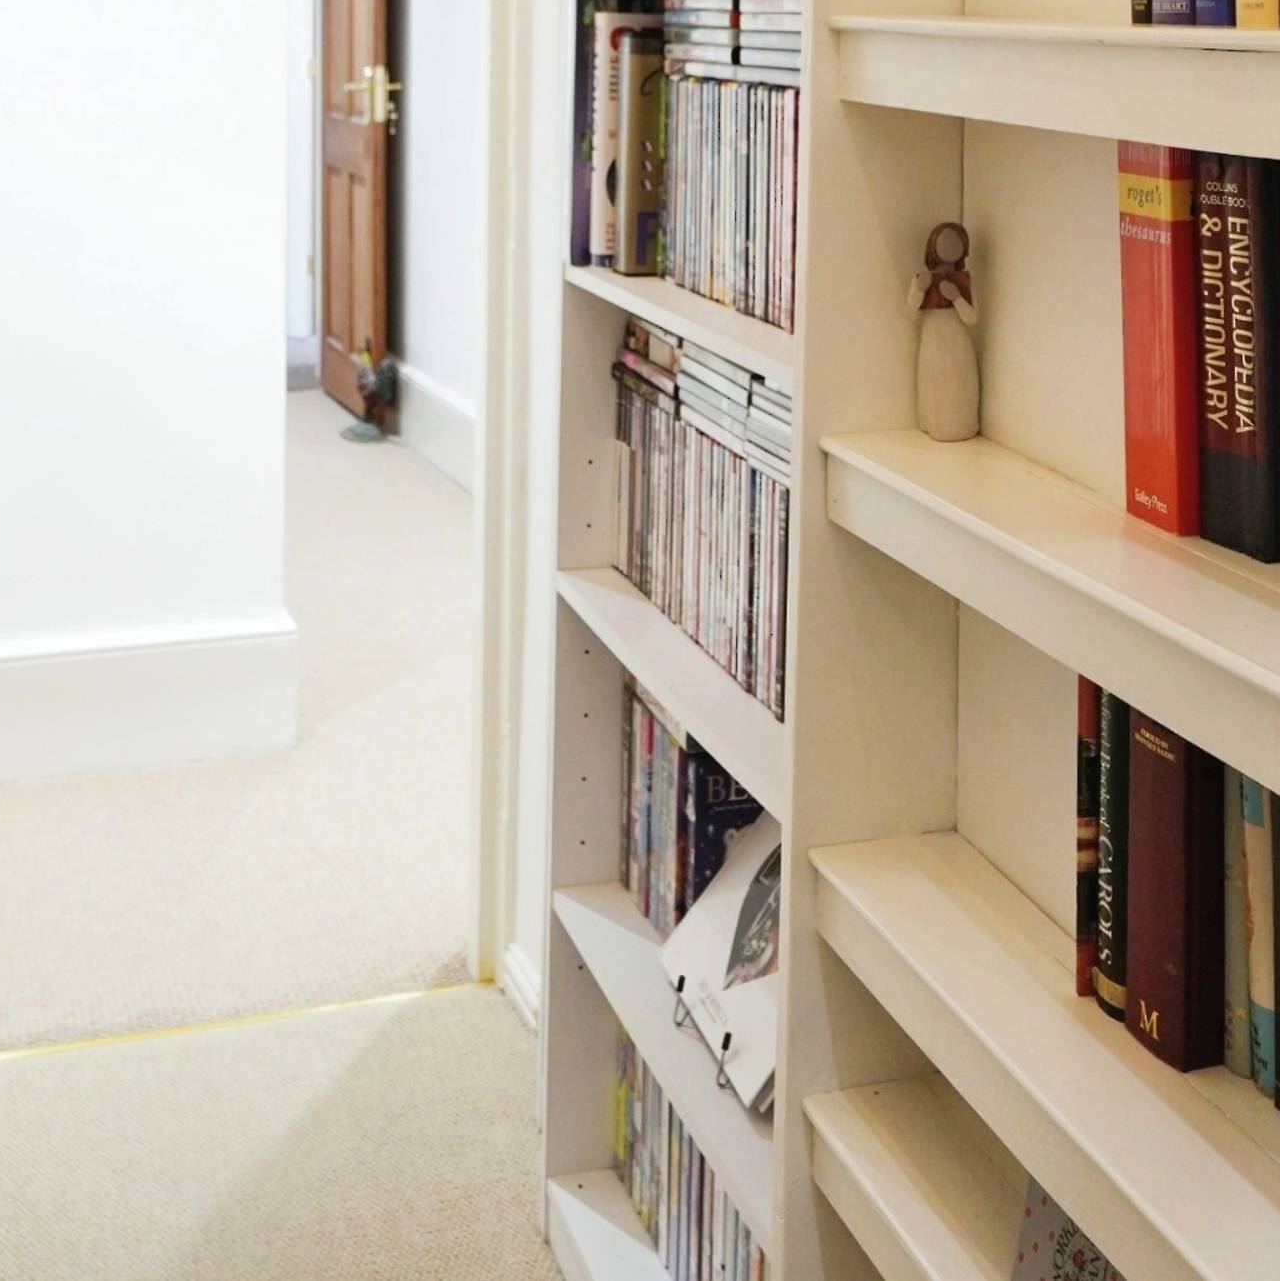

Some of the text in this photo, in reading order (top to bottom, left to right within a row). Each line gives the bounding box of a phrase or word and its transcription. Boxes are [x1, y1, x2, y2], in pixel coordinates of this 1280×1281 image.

[1121, 218, 1171, 246] thesaurus
[1126, 185, 1162, 207] roget's
[1200, 213, 1228, 430] & DICTIONARY
[1228, 216, 1256, 433] ENCYCLOPEDIA
[1099, 835, 1113, 965] CAROLS
[1139, 998, 1159, 1041] M
